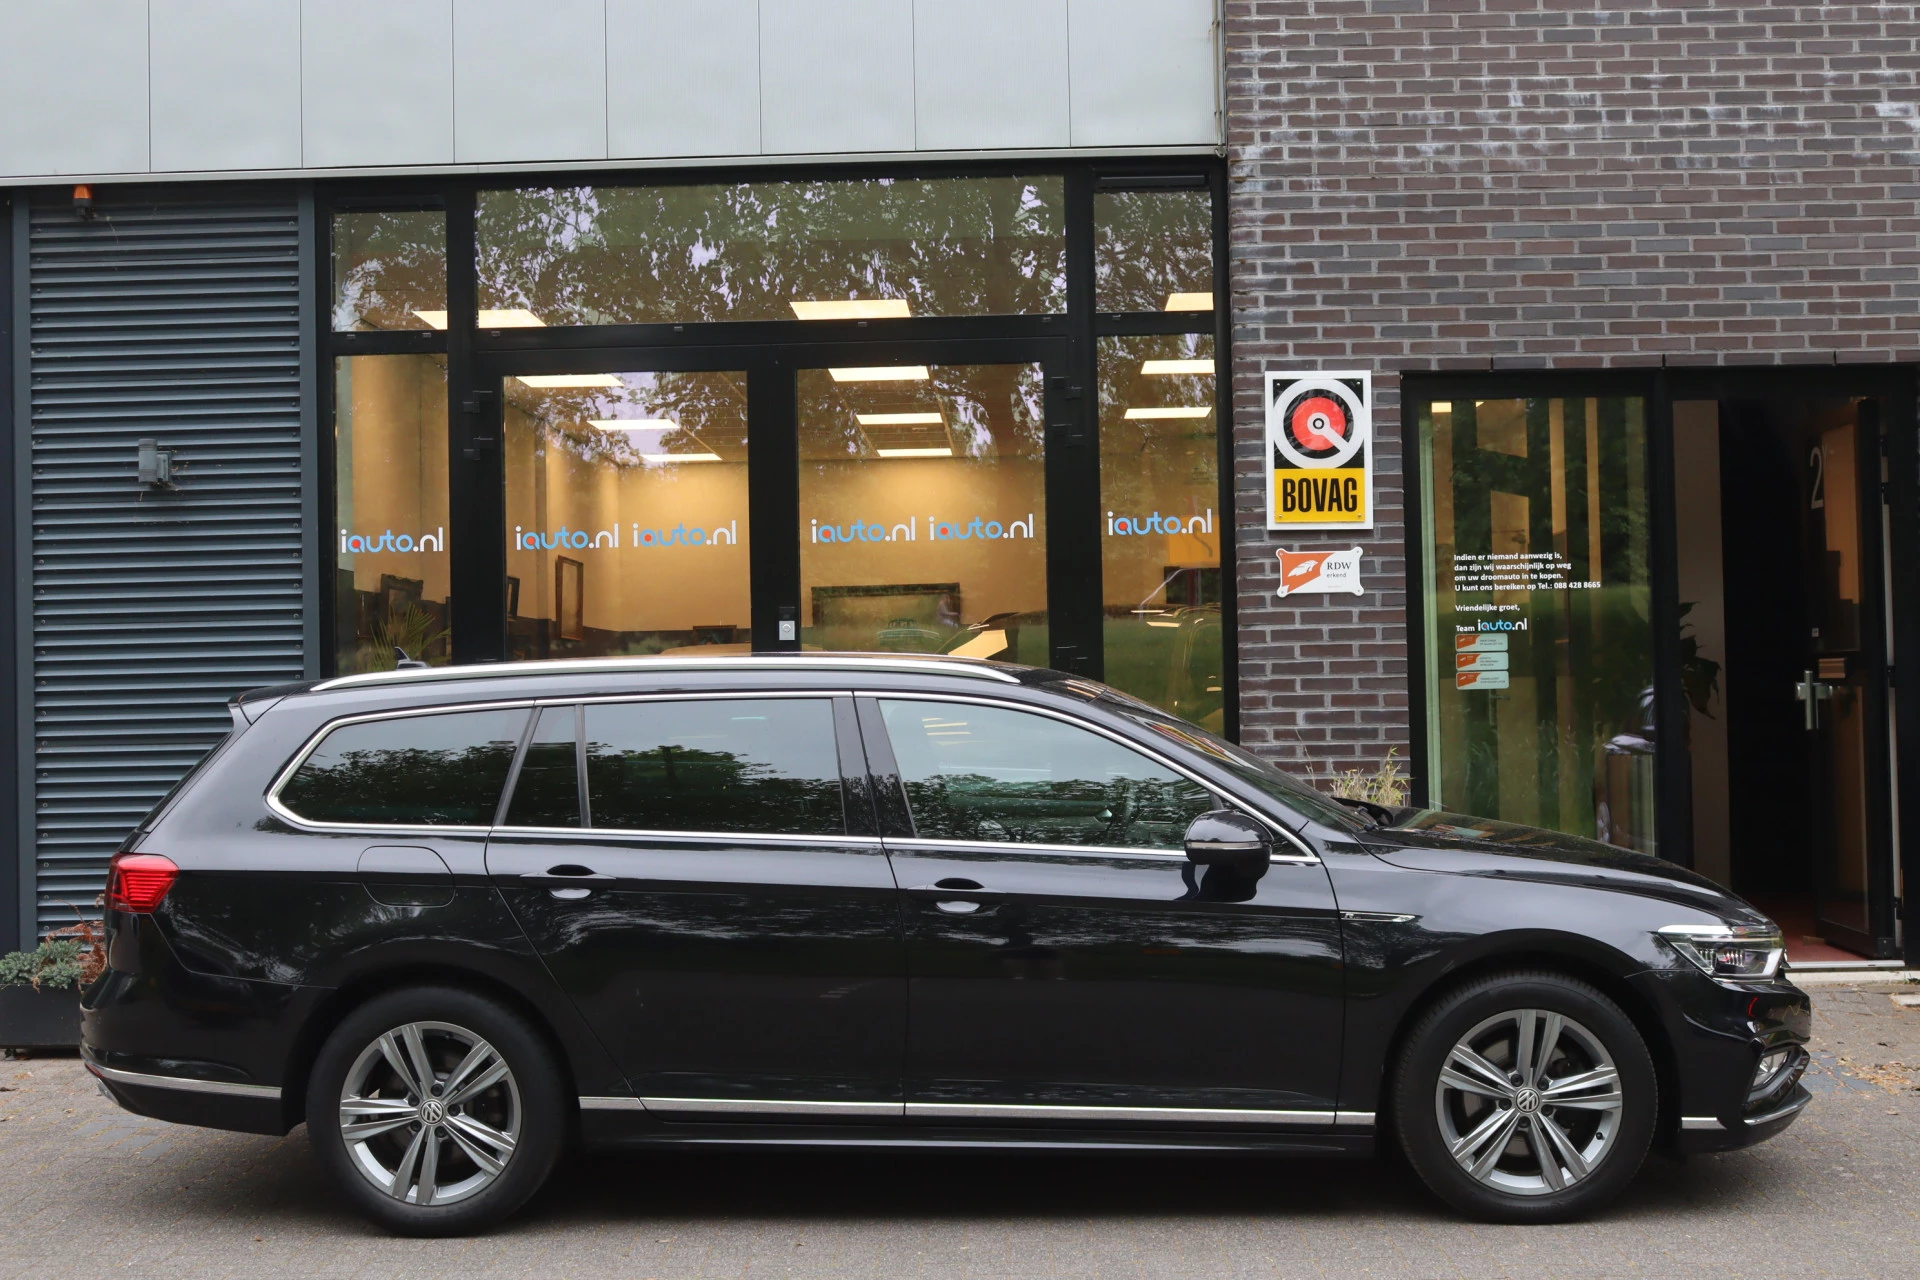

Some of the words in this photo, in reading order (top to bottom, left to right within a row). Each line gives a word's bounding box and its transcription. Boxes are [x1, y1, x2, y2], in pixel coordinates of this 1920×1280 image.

[1282, 477, 1358, 512] BOVAG
[811, 515, 916, 544] iauto.nl
[929, 513, 1034, 541] iauto.nl
[1107, 508, 1212, 536] iauto.nl
[340, 526, 444, 554] iauto.nl
[515, 523, 620, 551] iauto.nl
[632, 519, 737, 548] iauto.nl
[1326, 561, 1352, 570] RDW
[1519, 551, 1553, 561] aanwezig
[1554, 551, 1563, 560] is,
[1469, 563, 1482, 572] zijn
[1483, 563, 1494, 572] wij
[1495, 562, 1544, 571] waarschijnlijk
[1539, 572, 1564, 581] kopen.
[1494, 582, 1525, 591] bereiken
[1526, 583, 1537, 592] op
[1454, 603, 1498, 613] Vriendelijke
[1498, 603, 1521, 612] groet,
[1477, 617, 1528, 632] iauto.nl
